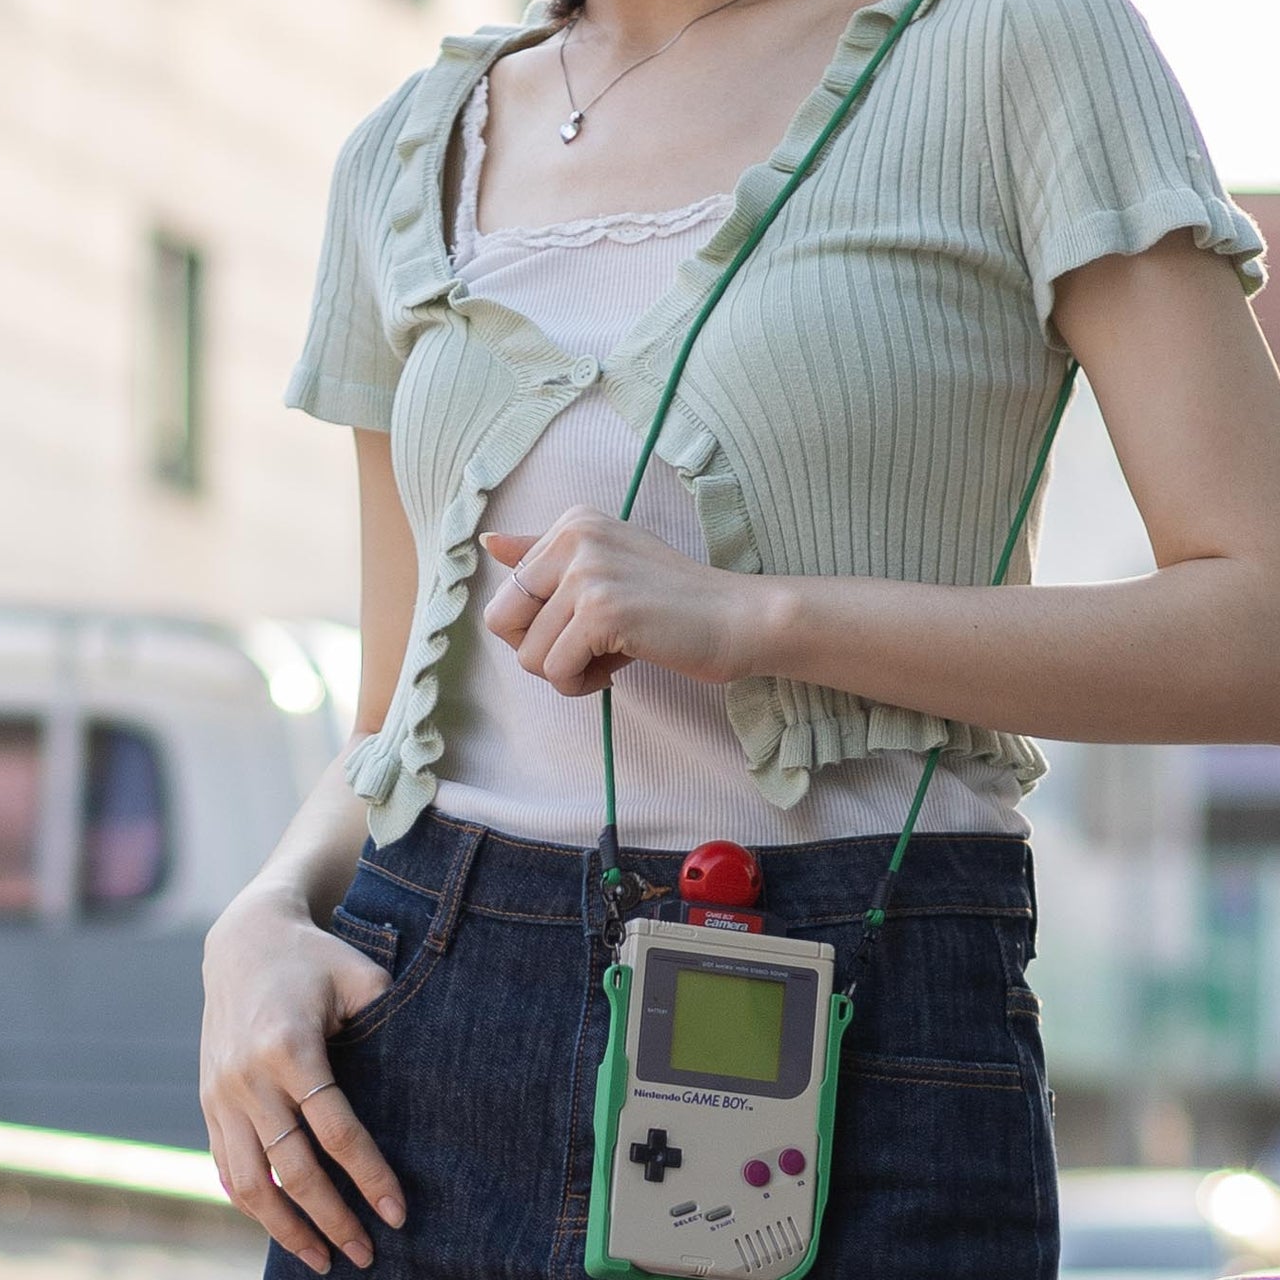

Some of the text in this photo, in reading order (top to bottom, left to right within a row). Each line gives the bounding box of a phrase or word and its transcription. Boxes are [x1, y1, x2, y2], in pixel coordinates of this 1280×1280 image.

[705, 918, 748, 931] camera
[634, 1088, 681, 1101] Nintendo
[682, 1091, 720, 1107] GAME
[673, 1213, 703, 1228] SELECT
